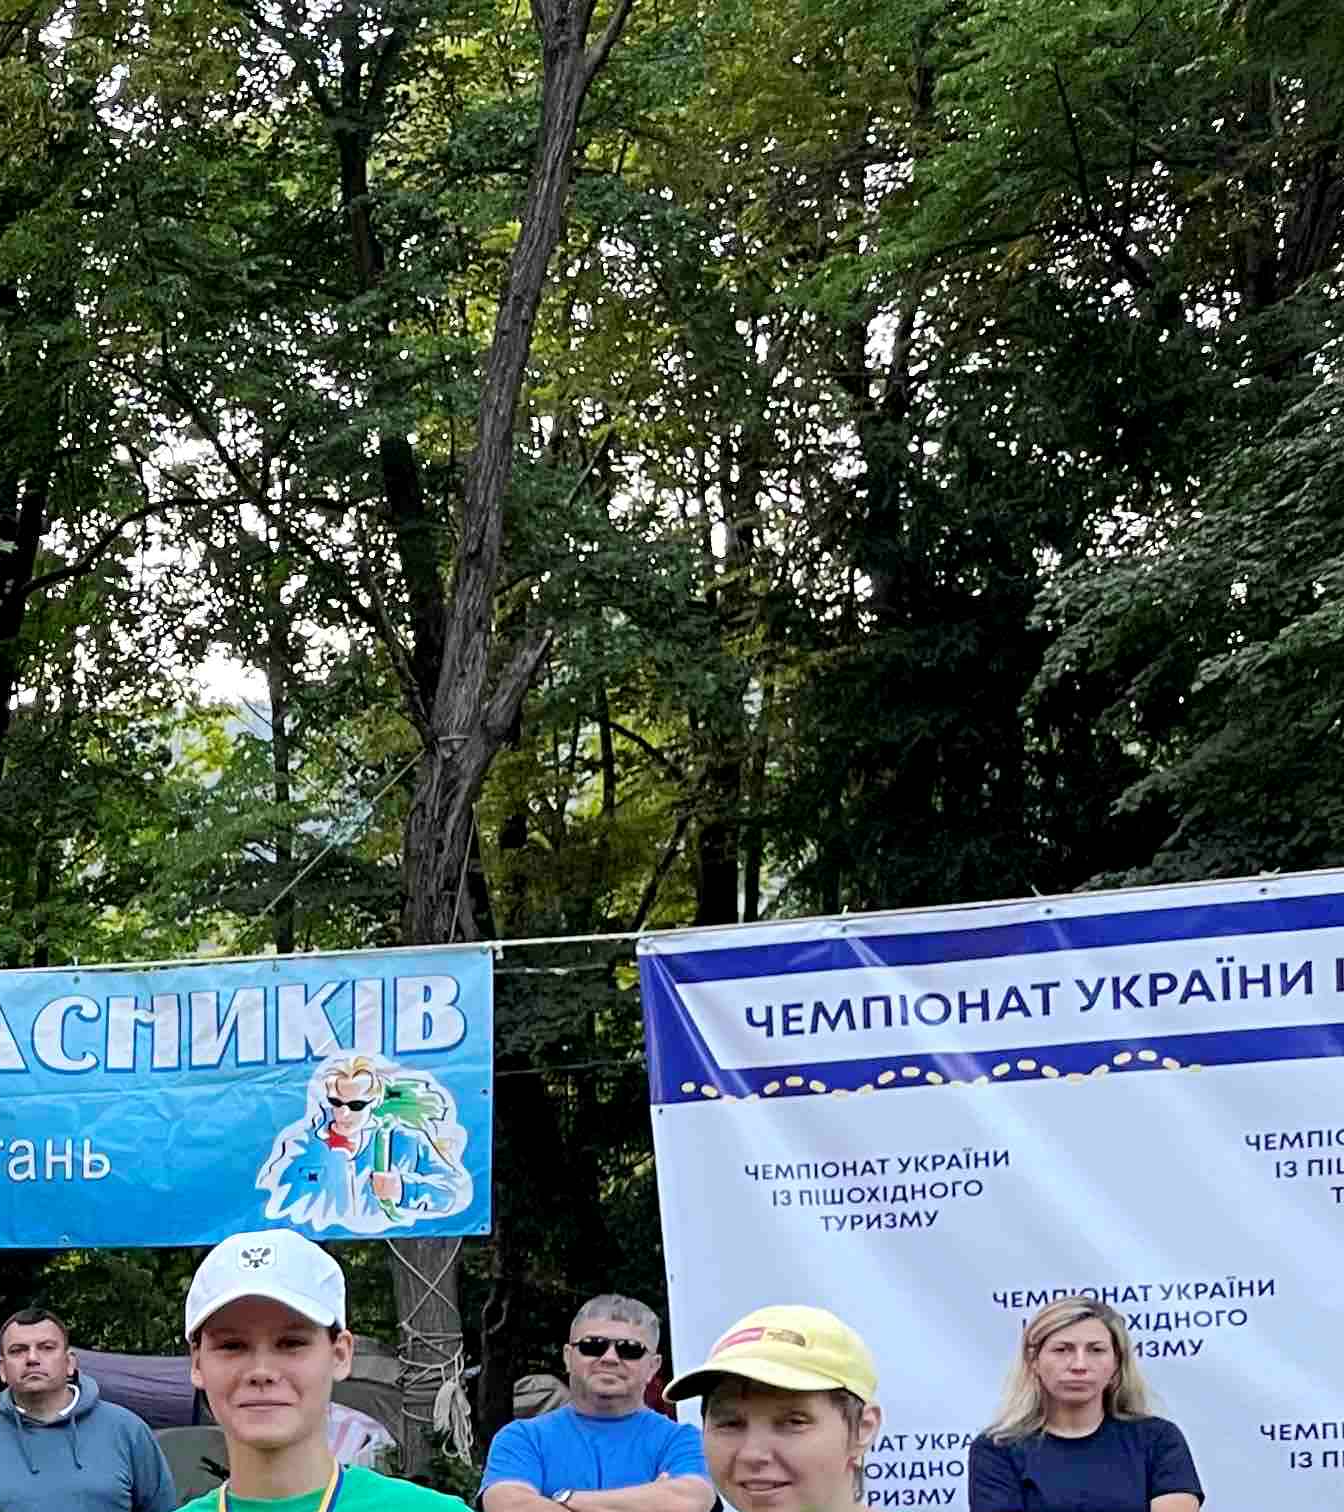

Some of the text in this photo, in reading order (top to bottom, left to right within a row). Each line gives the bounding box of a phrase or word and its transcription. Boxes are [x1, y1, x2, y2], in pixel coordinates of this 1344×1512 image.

[745, 983, 1060, 1038] ЧЕМПІОНАТ
[1075, 955, 1313, 1014] УКРАЇНИ
[744, 1147, 1010, 1181] ЧЕМПІОНАТ УКРАЇНИ
[1275, 1160, 1298, 1178] ІЗ
[772, 1180, 984, 1207] ІЗ ПІШОХІДНОГО
[820, 1210, 939, 1232] ТУРИЗМУ
[1160, 1275, 1276, 1301] УКРАЇНИ
[1122, 1309, 1248, 1332] ХІДНОГО
[914, 1433, 973, 1451] УКРА
[1260, 1423, 1344, 1441] ЧЕМП
[864, 1460, 965, 1480] ОХІДНО
[1290, 1451, 1312, 1468] ІЗ
[867, 1487, 956, 1508] РИЗМУ
